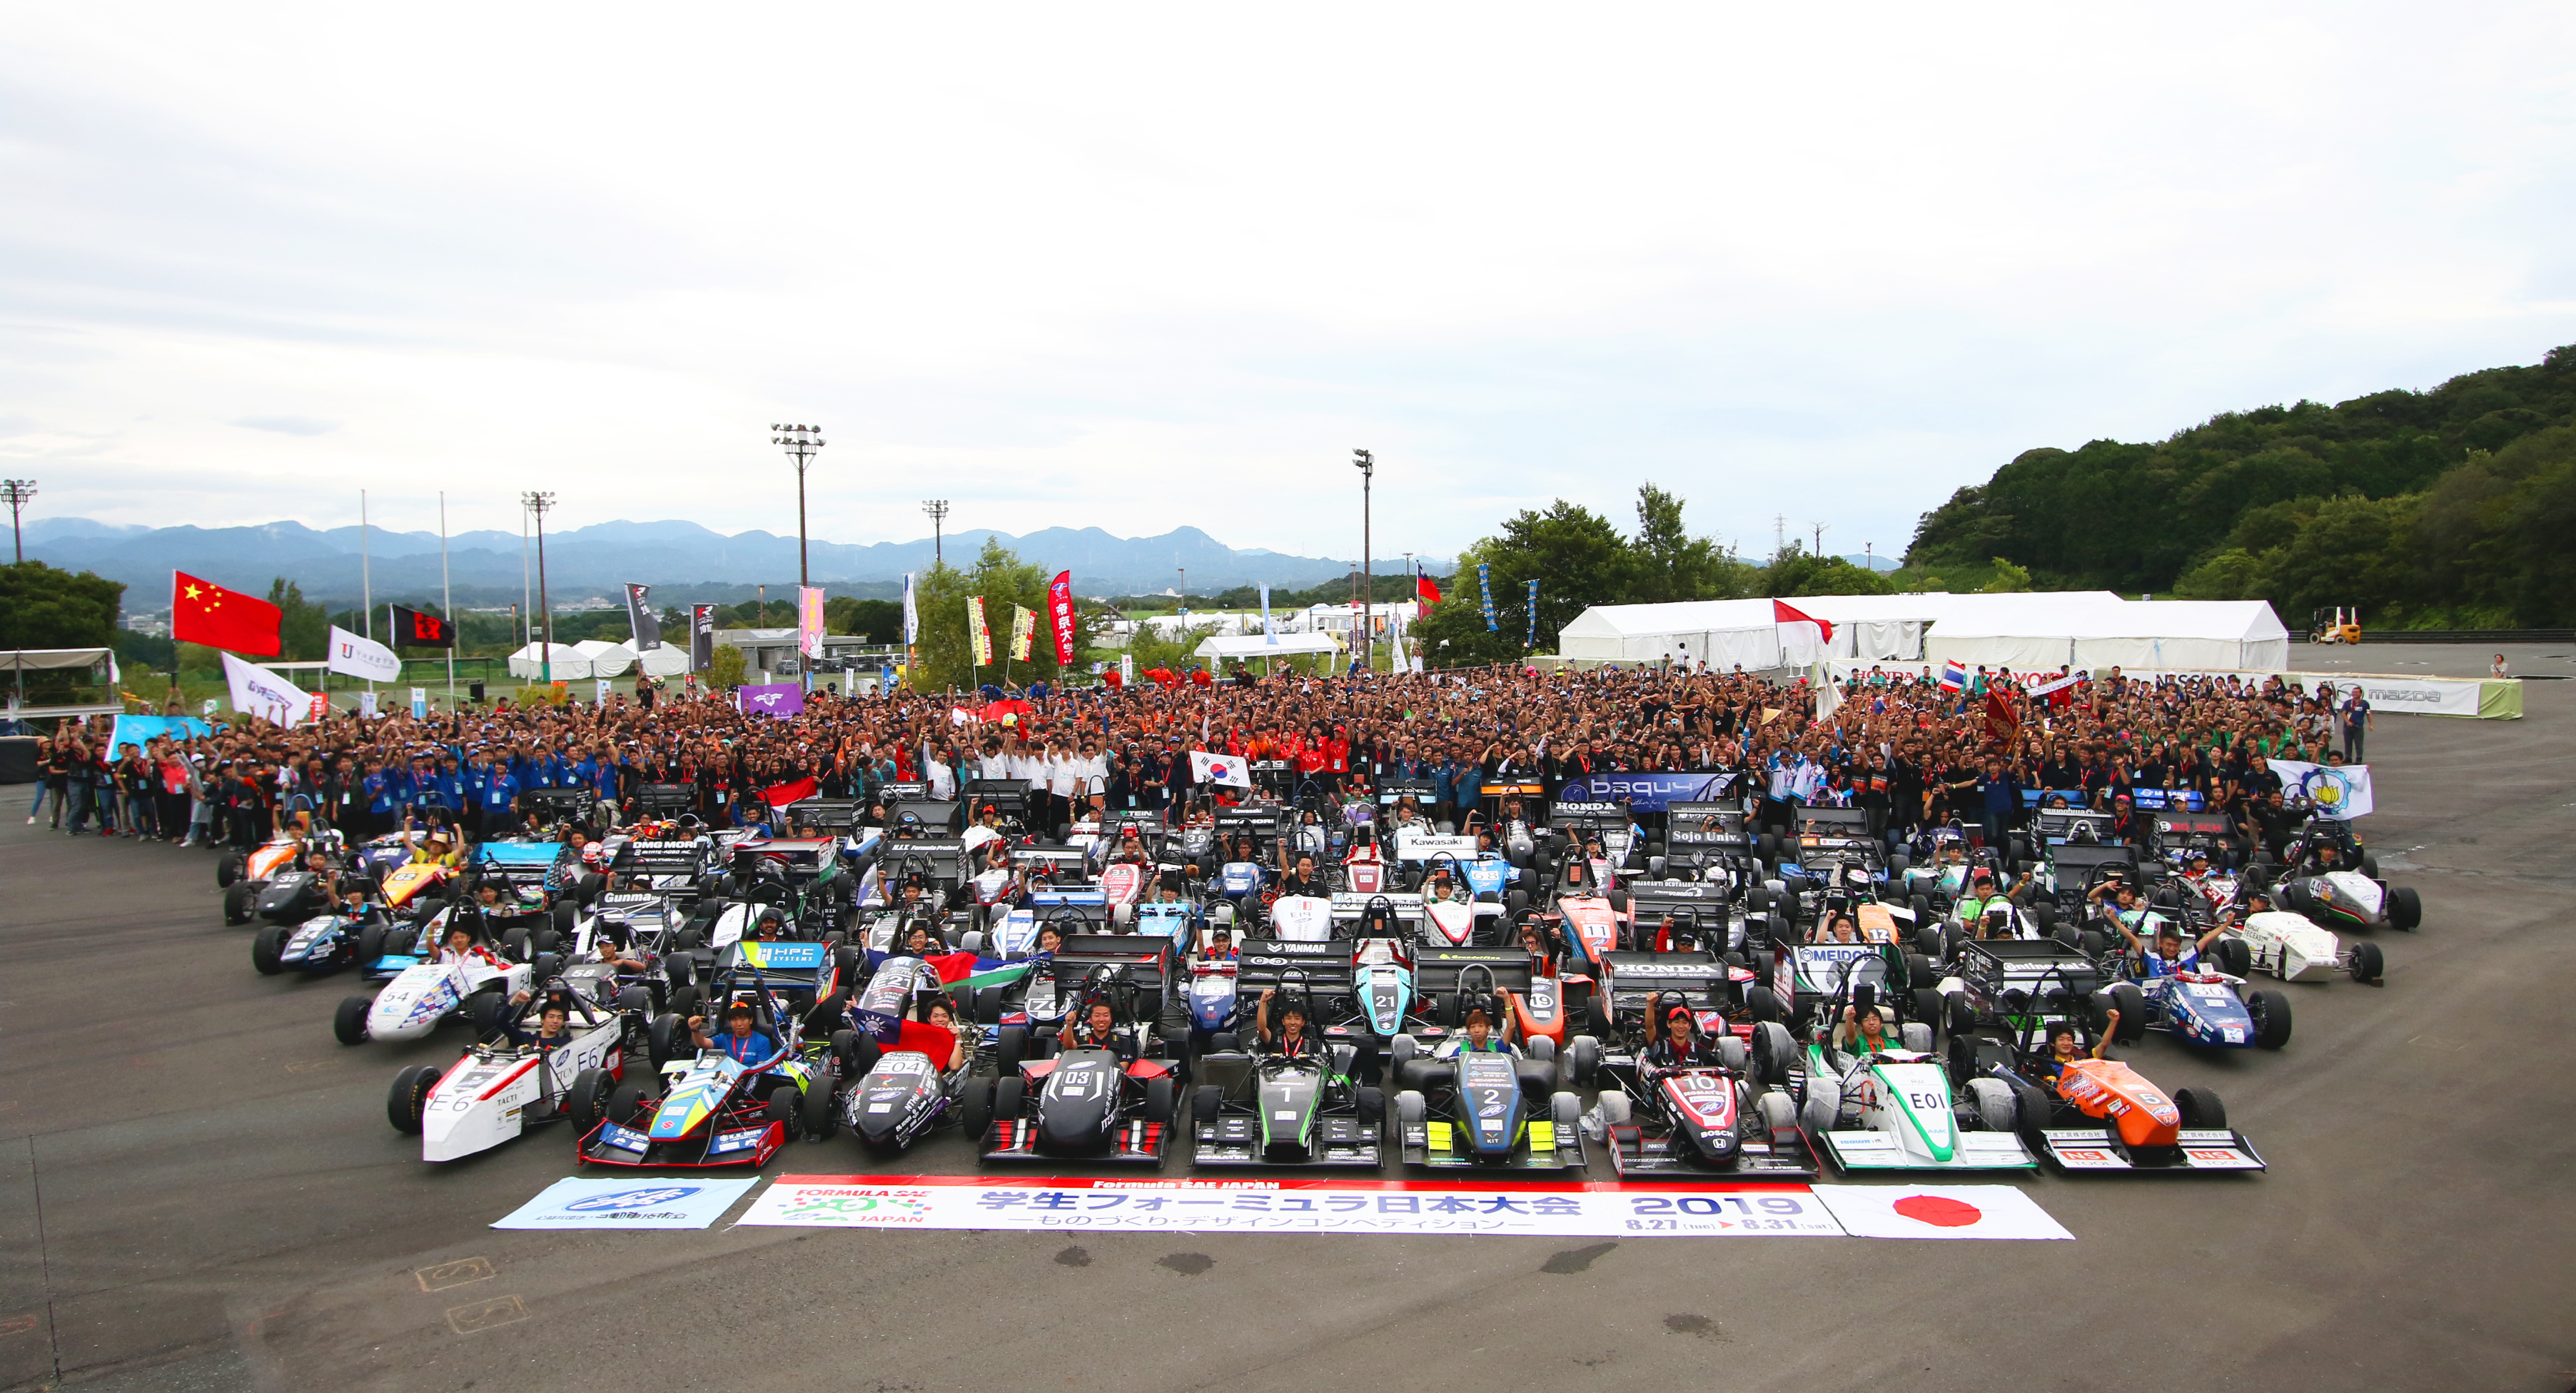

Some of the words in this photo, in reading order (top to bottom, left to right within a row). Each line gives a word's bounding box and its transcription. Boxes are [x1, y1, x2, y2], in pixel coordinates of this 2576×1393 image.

[1056, 602, 1074, 656] 帝京大学
[1555, 802, 1617, 811] HONDA
[1186, 835, 1206, 844] 39
[1411, 837, 1463, 847] Kawasaki
[1672, 830, 1702, 844] Sojo
[1705, 831, 1742, 842] Univ.
[633, 841, 663, 849] DMG
[664, 841, 697, 849] MORI
[698, 861, 705, 876] 26
[1473, 871, 1497, 881] 68
[2309, 879, 2321, 896] 44
[604, 892, 651, 903] Gunma
[662, 899, 670, 914] 58
[1587, 926, 1606, 936] 11
[2244, 921, 2260, 932] HONDA
[294, 931, 317, 939] 24
[1872, 929, 1889, 939] 12
[877, 935, 892, 945] 7
[1283, 943, 1326, 953] YANMAR
[1615, 964, 1718, 973] HONDA
[519, 973, 530, 990] 54
[1200, 986, 1224, 996] E5
[2193, 984, 2225, 996] 30
[383, 992, 410, 1003] 54
[1375, 995, 1395, 1008] 21
[1837, 1050, 1854, 1063] NAGOYA
[874, 1061, 921, 1073] E04
[1065, 1071, 1090, 1085] 03
[1682, 1076, 1716, 1090] 10
[2062, 1073, 2083, 1090] OILES
[497, 1094, 518, 1106] TACTI
[1281, 1087, 1291, 1103] 1
[1483, 1090, 1500, 1105] 2
[2141, 1094, 2161, 1105] 5
[427, 1093, 474, 1112] E6
[1910, 1093, 1946, 1110] E01
[1700, 1130, 1734, 1139] BOSCH
[1092, 1180, 1176, 1189] Formula
[975, 1191, 1584, 1216] 学生フォーミュラ日本大会
[1631, 1197, 1804, 1215] 2019
[1625, 1219, 1677, 1230] 8.27
[1742, 1219, 1796, 1230] 8.31
